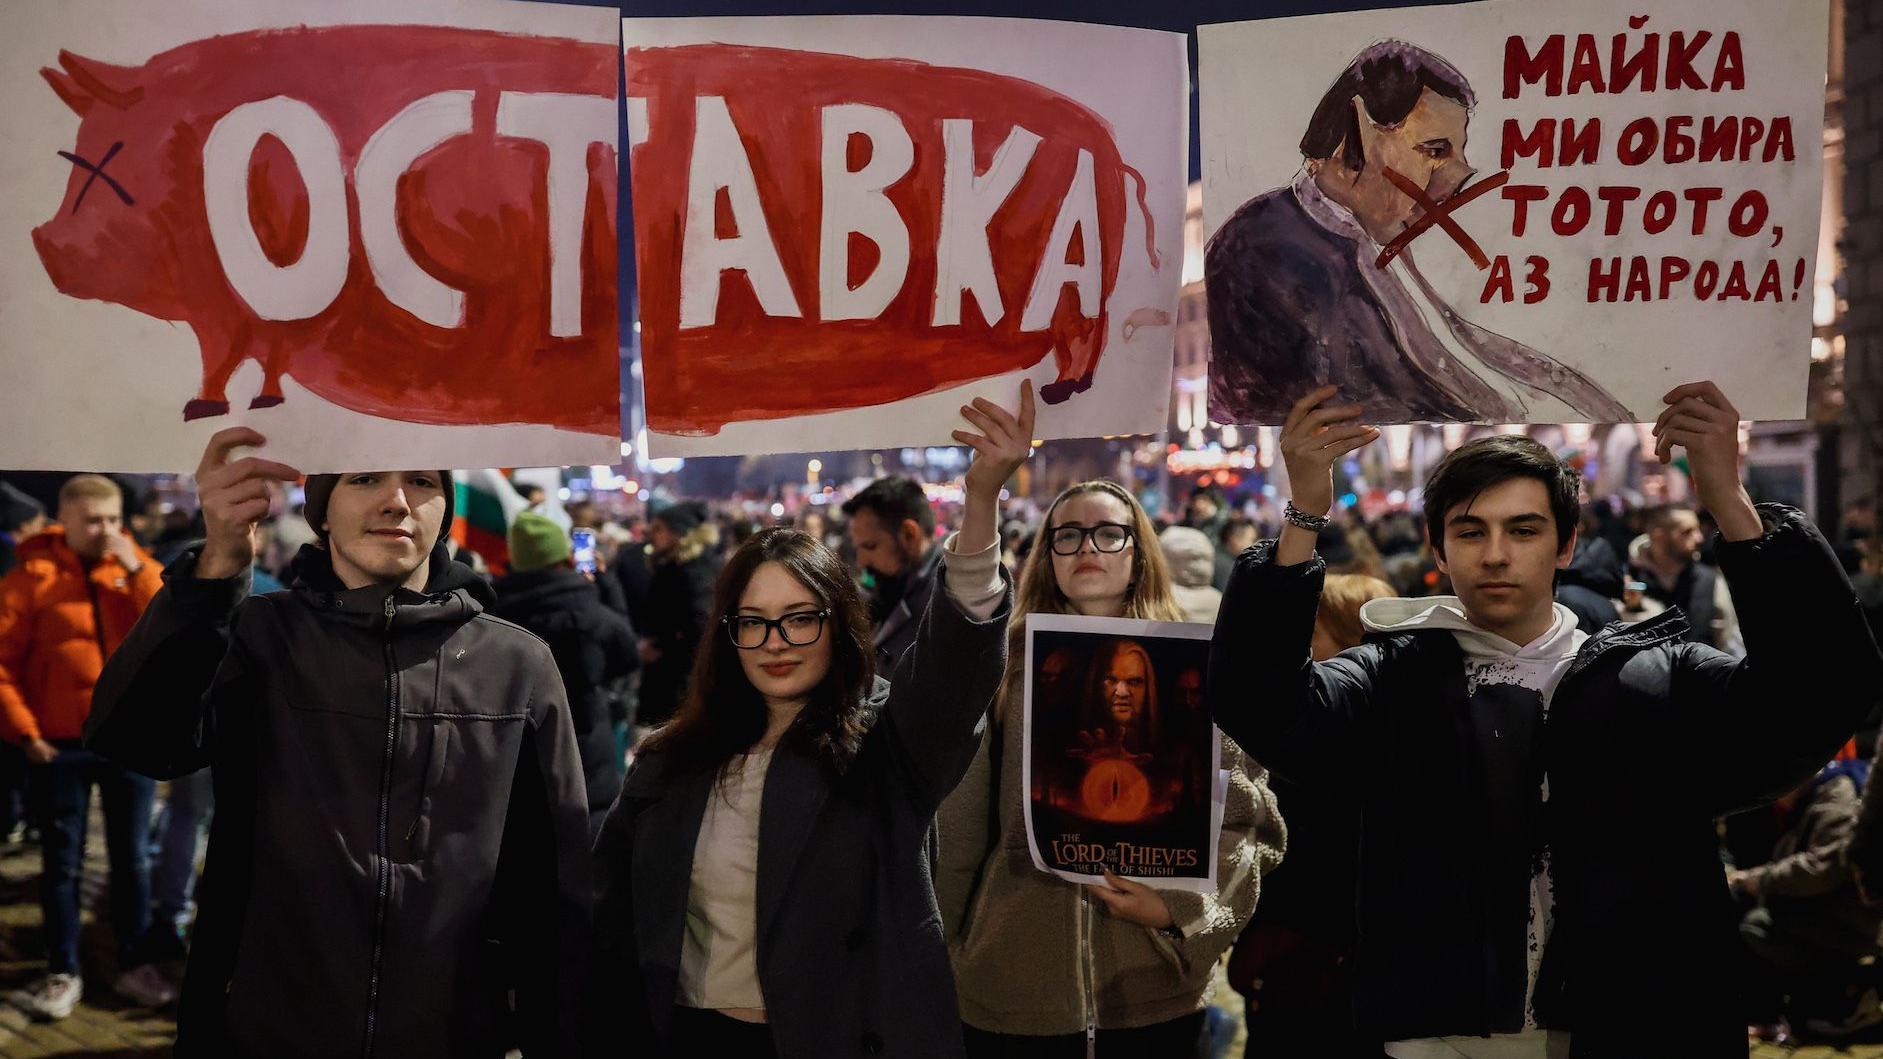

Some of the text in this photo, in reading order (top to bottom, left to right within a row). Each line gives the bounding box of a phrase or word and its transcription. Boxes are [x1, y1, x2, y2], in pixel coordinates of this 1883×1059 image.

[1503, 15, 1745, 99] МАЙКА
[1500, 115, 1795, 170] МИ ОБИРА
[202, 89, 1104, 338] ОСТАВКА
[1501, 184, 1783, 248] ТОТОТО,
[1480, 255, 1805, 304] АЗ НАРОДА!
[1051, 840, 1105, 865] LORD
[1106, 848, 1118, 857] OF
[1115, 842, 1198, 867] THIEVES
[1061, 833, 1081, 842] THE
[1072, 863, 1093, 873] THE
[1120, 865, 1135, 875] OF
[1138, 866, 1174, 876] SHISHI
